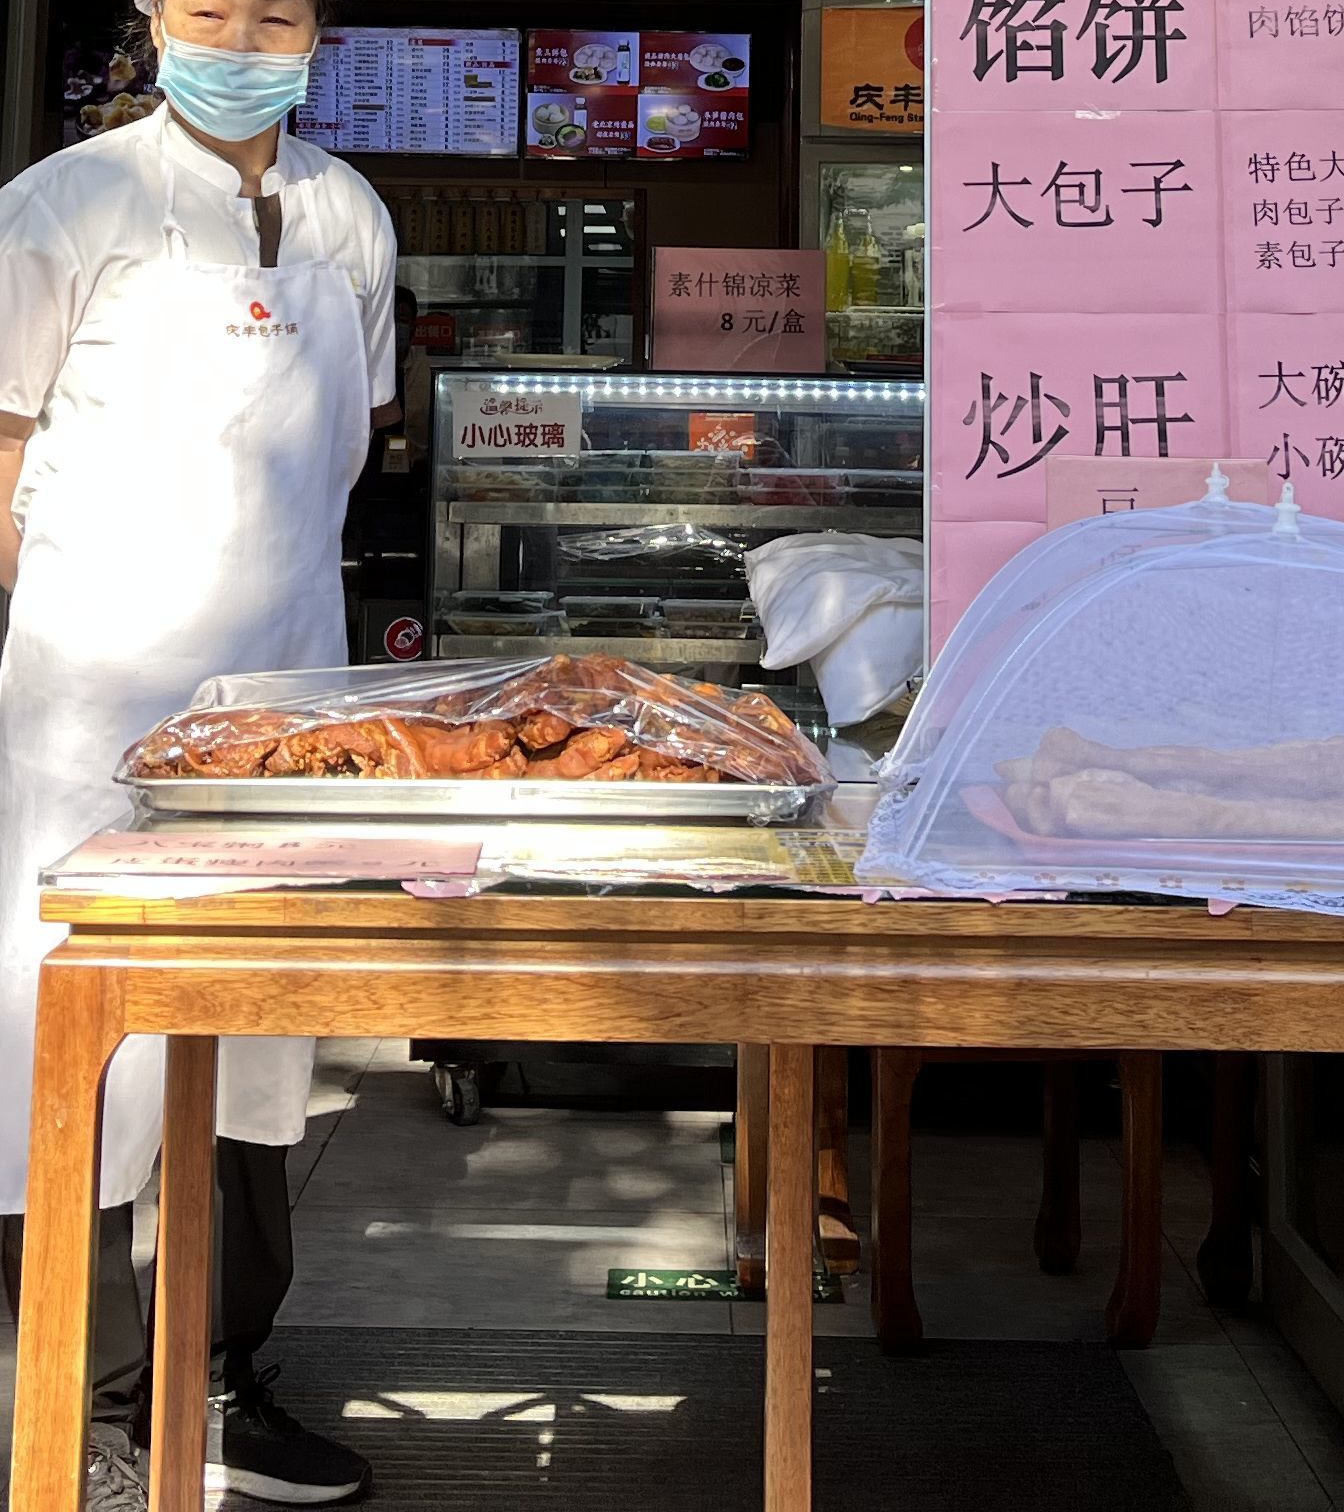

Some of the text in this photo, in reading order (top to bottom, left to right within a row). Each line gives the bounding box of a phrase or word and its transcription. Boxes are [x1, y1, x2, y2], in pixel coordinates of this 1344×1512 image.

[849, 83, 923, 111] 庆丰
[849, 112, 904, 123] Qing-Feng
[961, 158, 1194, 232] 大包子
[1252, 196, 1344, 228] 肉包子
[667, 269, 803, 301] 素什锦凉菜
[720, 309, 806, 334] 8 元/盒
[460, 422, 566, 449] 小心玻璃
[961, 370, 1196, 481] 炒肝
